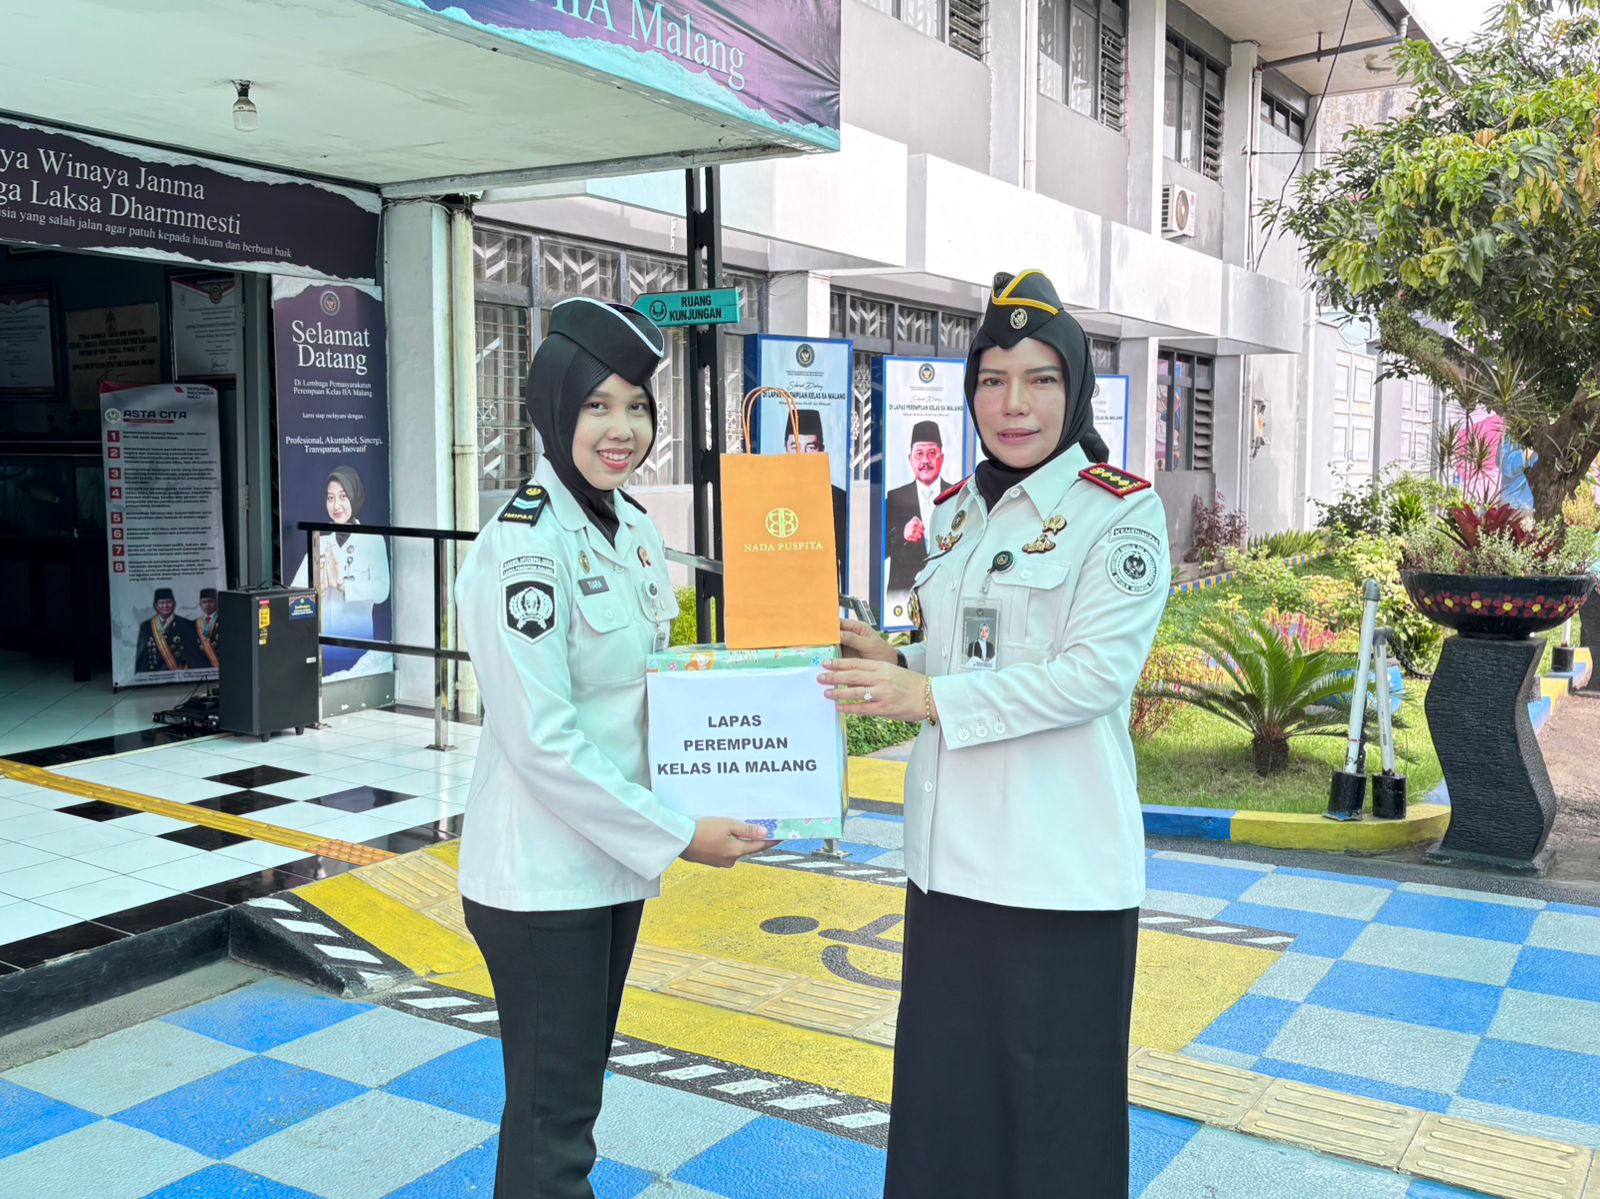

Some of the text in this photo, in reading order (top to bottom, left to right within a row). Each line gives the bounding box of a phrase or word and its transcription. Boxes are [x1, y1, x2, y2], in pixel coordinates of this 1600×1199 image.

[628, 0, 745, 91] Malang
[37, 148, 130, 190] Winaya
[136, 167, 206, 200] Janma
[30, 179, 102, 213] Laksa
[109, 192, 241, 234] Dharmmesti
[19, 211, 46, 226] yang
[48, 214, 76, 227] salah
[77, 217, 102, 230] jalan
[105, 224, 128, 235] agar
[128, 228, 156, 238] patuh
[158, 230, 190, 243] kepada
[192, 234, 223, 248] hukum
[225, 240, 240, 250] dan
[242, 242, 273, 255] berbuat
[274, 246, 292, 258] baik
[682, 295, 712, 308] RUANG
[669, 308, 722, 321] KUNJUNGAN
[292, 320, 372, 348] Selamat
[298, 344, 368, 376] Datang
[302, 380, 328, 389] Lembaga
[293, 387, 324, 396] Perempuan
[352, 390, 372, 398] Malang
[123, 410, 187, 419] ASTA CITA
[342, 445, 367, 453] Inovatif
[113, 513, 121, 522] 5
[114, 530, 121, 538] 6
[114, 546, 122, 555] 7
[744, 541, 824, 552] NADA PUSPITA
[115, 563, 123, 571] 8
[708, 714, 762, 728] LAPAS
[684, 736, 788, 751] PEREMPUAN
[657, 759, 817, 775] KELAS IIA MALANG
